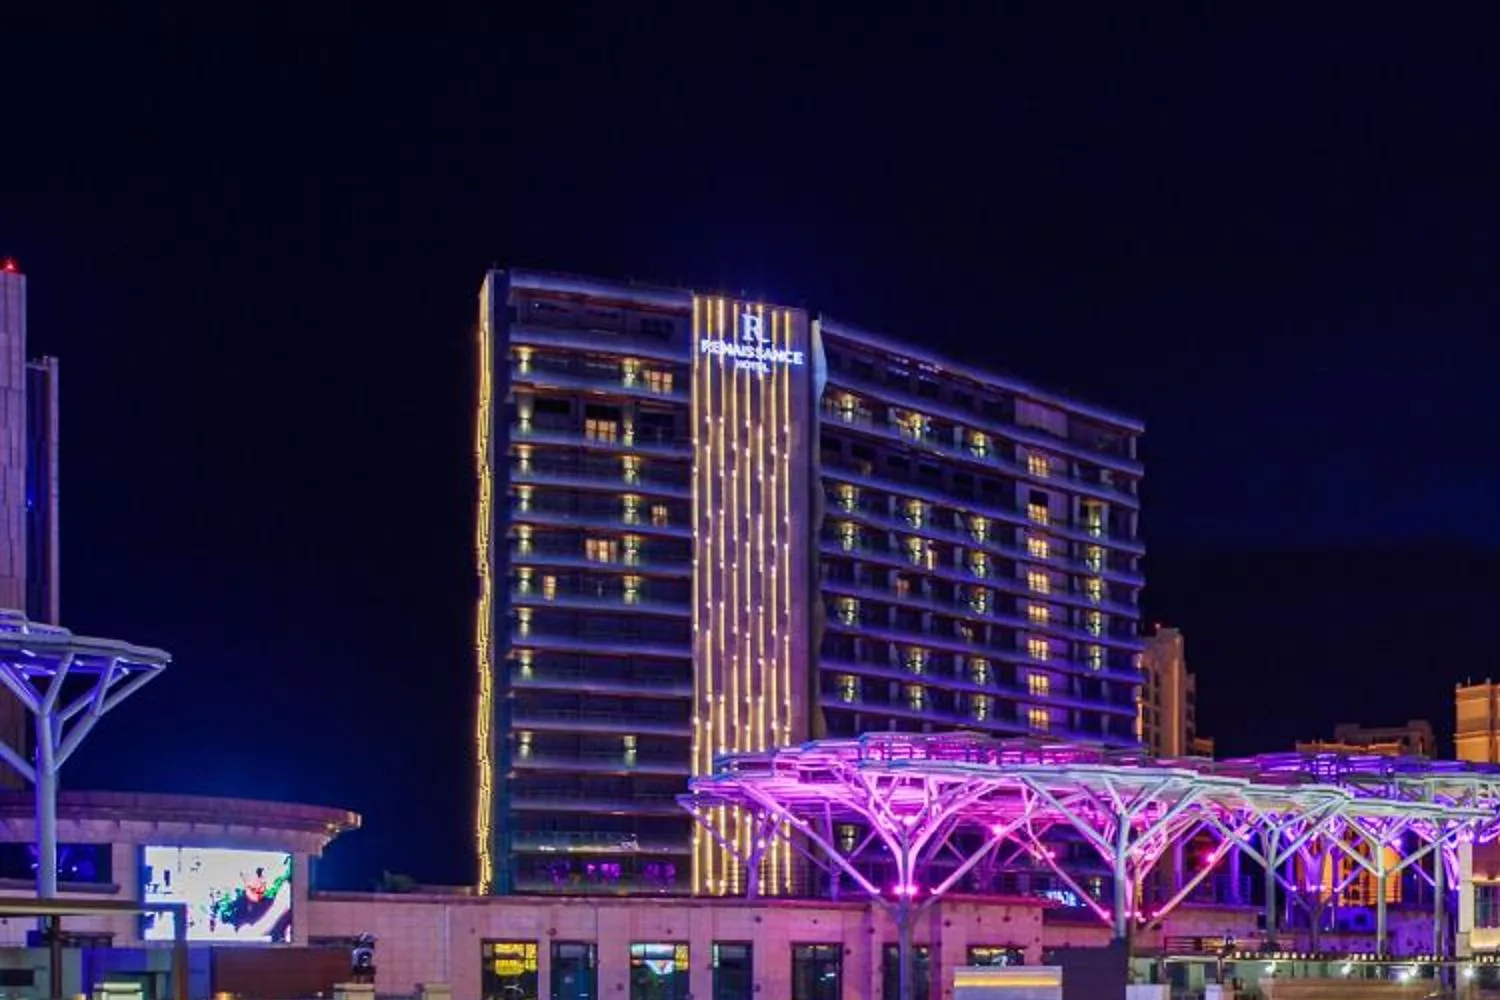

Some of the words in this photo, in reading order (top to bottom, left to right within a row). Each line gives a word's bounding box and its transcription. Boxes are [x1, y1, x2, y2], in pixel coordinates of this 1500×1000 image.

[743, 314, 770, 342] R
[701, 340, 803, 364] RENAISSANCE
[736, 360, 770, 373] HOTEL
